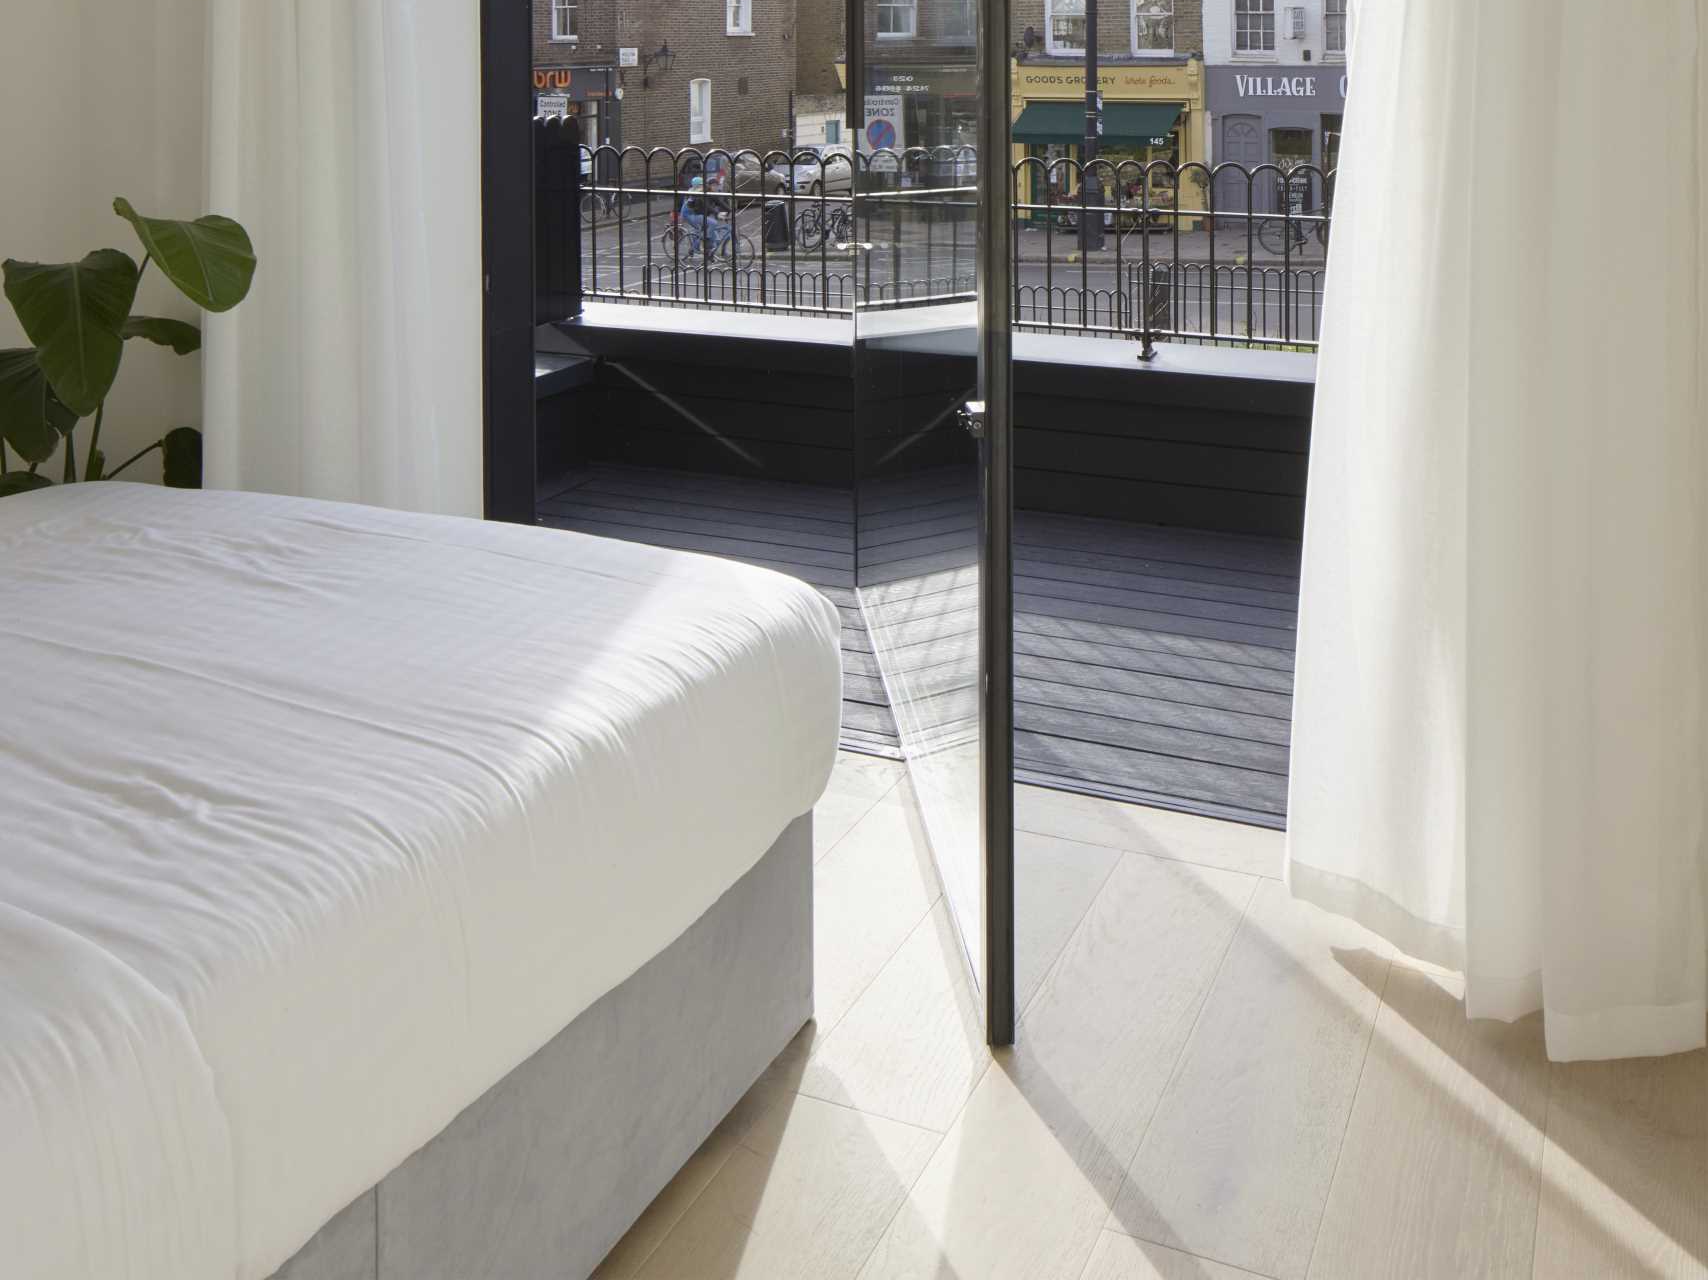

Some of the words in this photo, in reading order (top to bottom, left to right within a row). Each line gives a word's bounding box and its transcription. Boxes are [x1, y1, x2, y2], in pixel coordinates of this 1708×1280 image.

[1025, 76, 1063, 85] GOODS
[1065, 76, 1116, 85] GROERY
[1234, 74, 1317, 97] VILLAGE
[1150, 137, 1164, 145] 145
